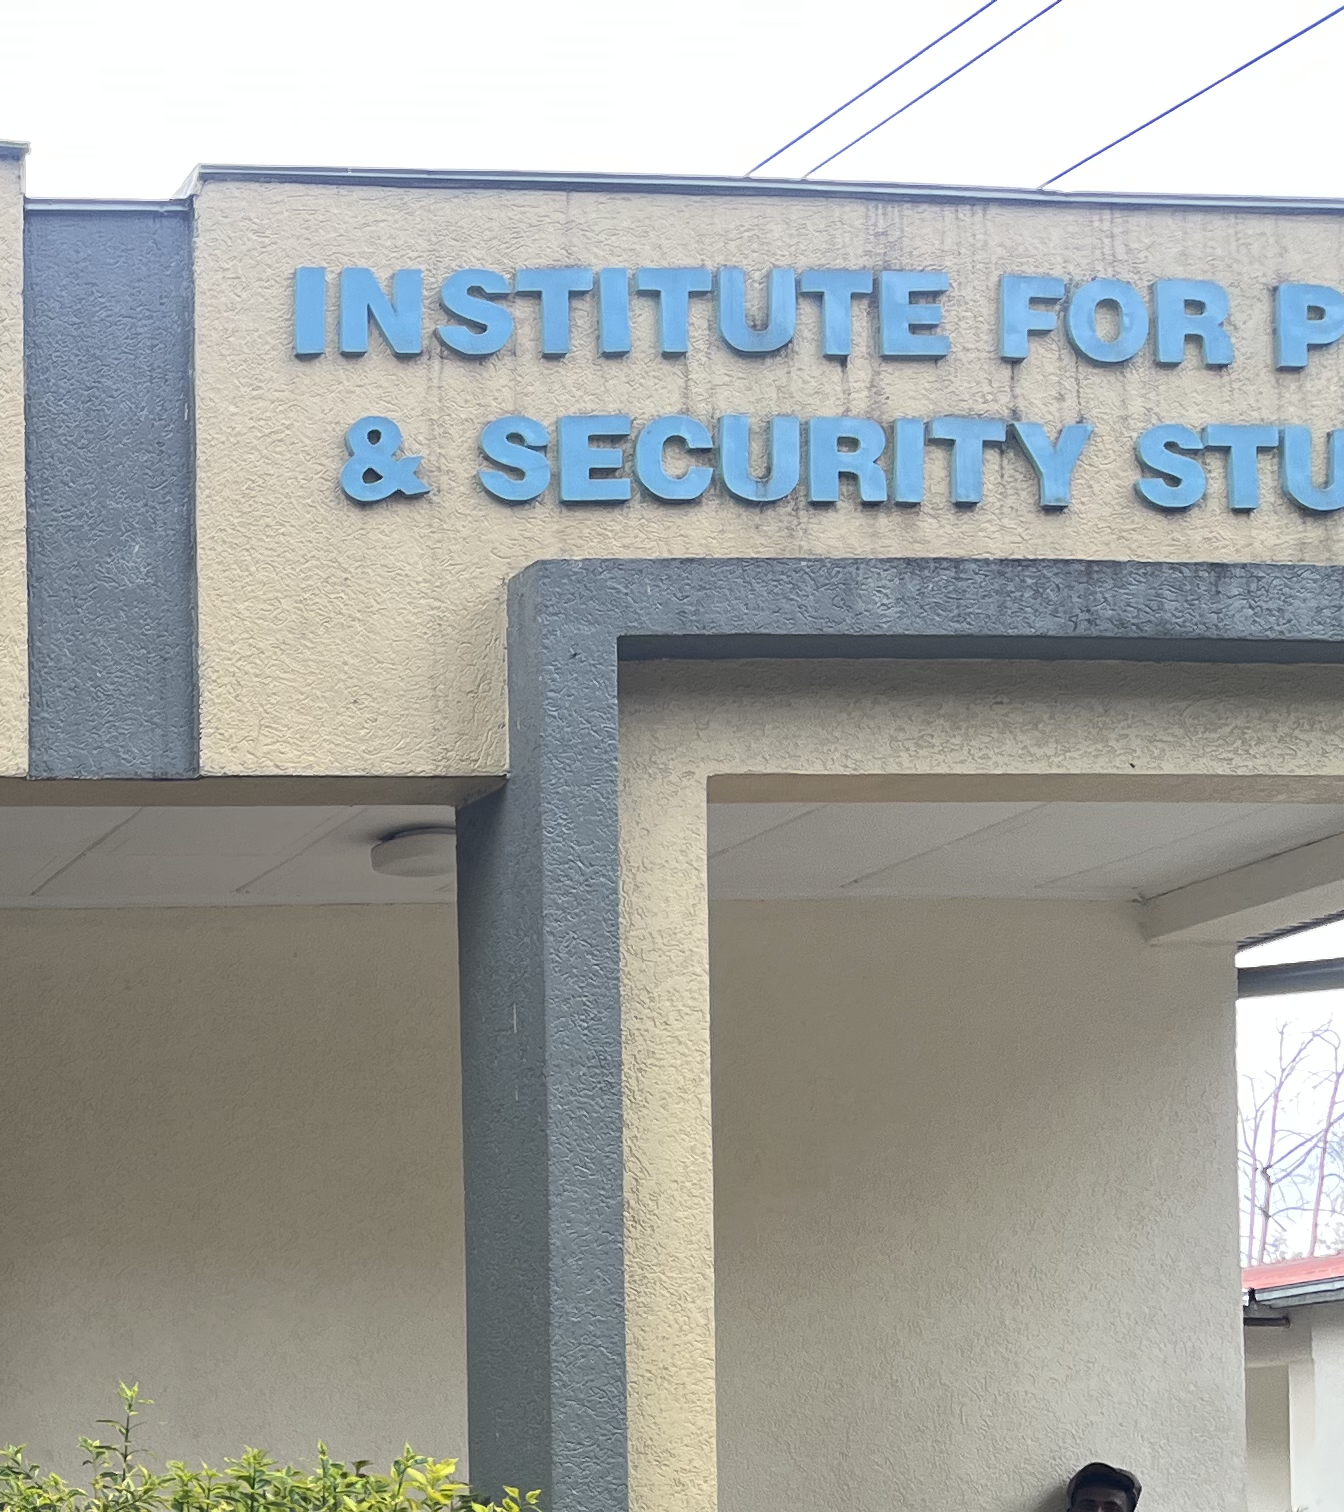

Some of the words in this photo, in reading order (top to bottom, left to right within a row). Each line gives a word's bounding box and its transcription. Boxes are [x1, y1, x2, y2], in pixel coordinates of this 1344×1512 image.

[294, 267, 951, 356] INSTITUTE
[1001, 275, 1234, 366] FOR
[340, 416, 430, 502] &
[477, 415, 1093, 508] SECURITY
[1137, 422, 1344, 511] STU
